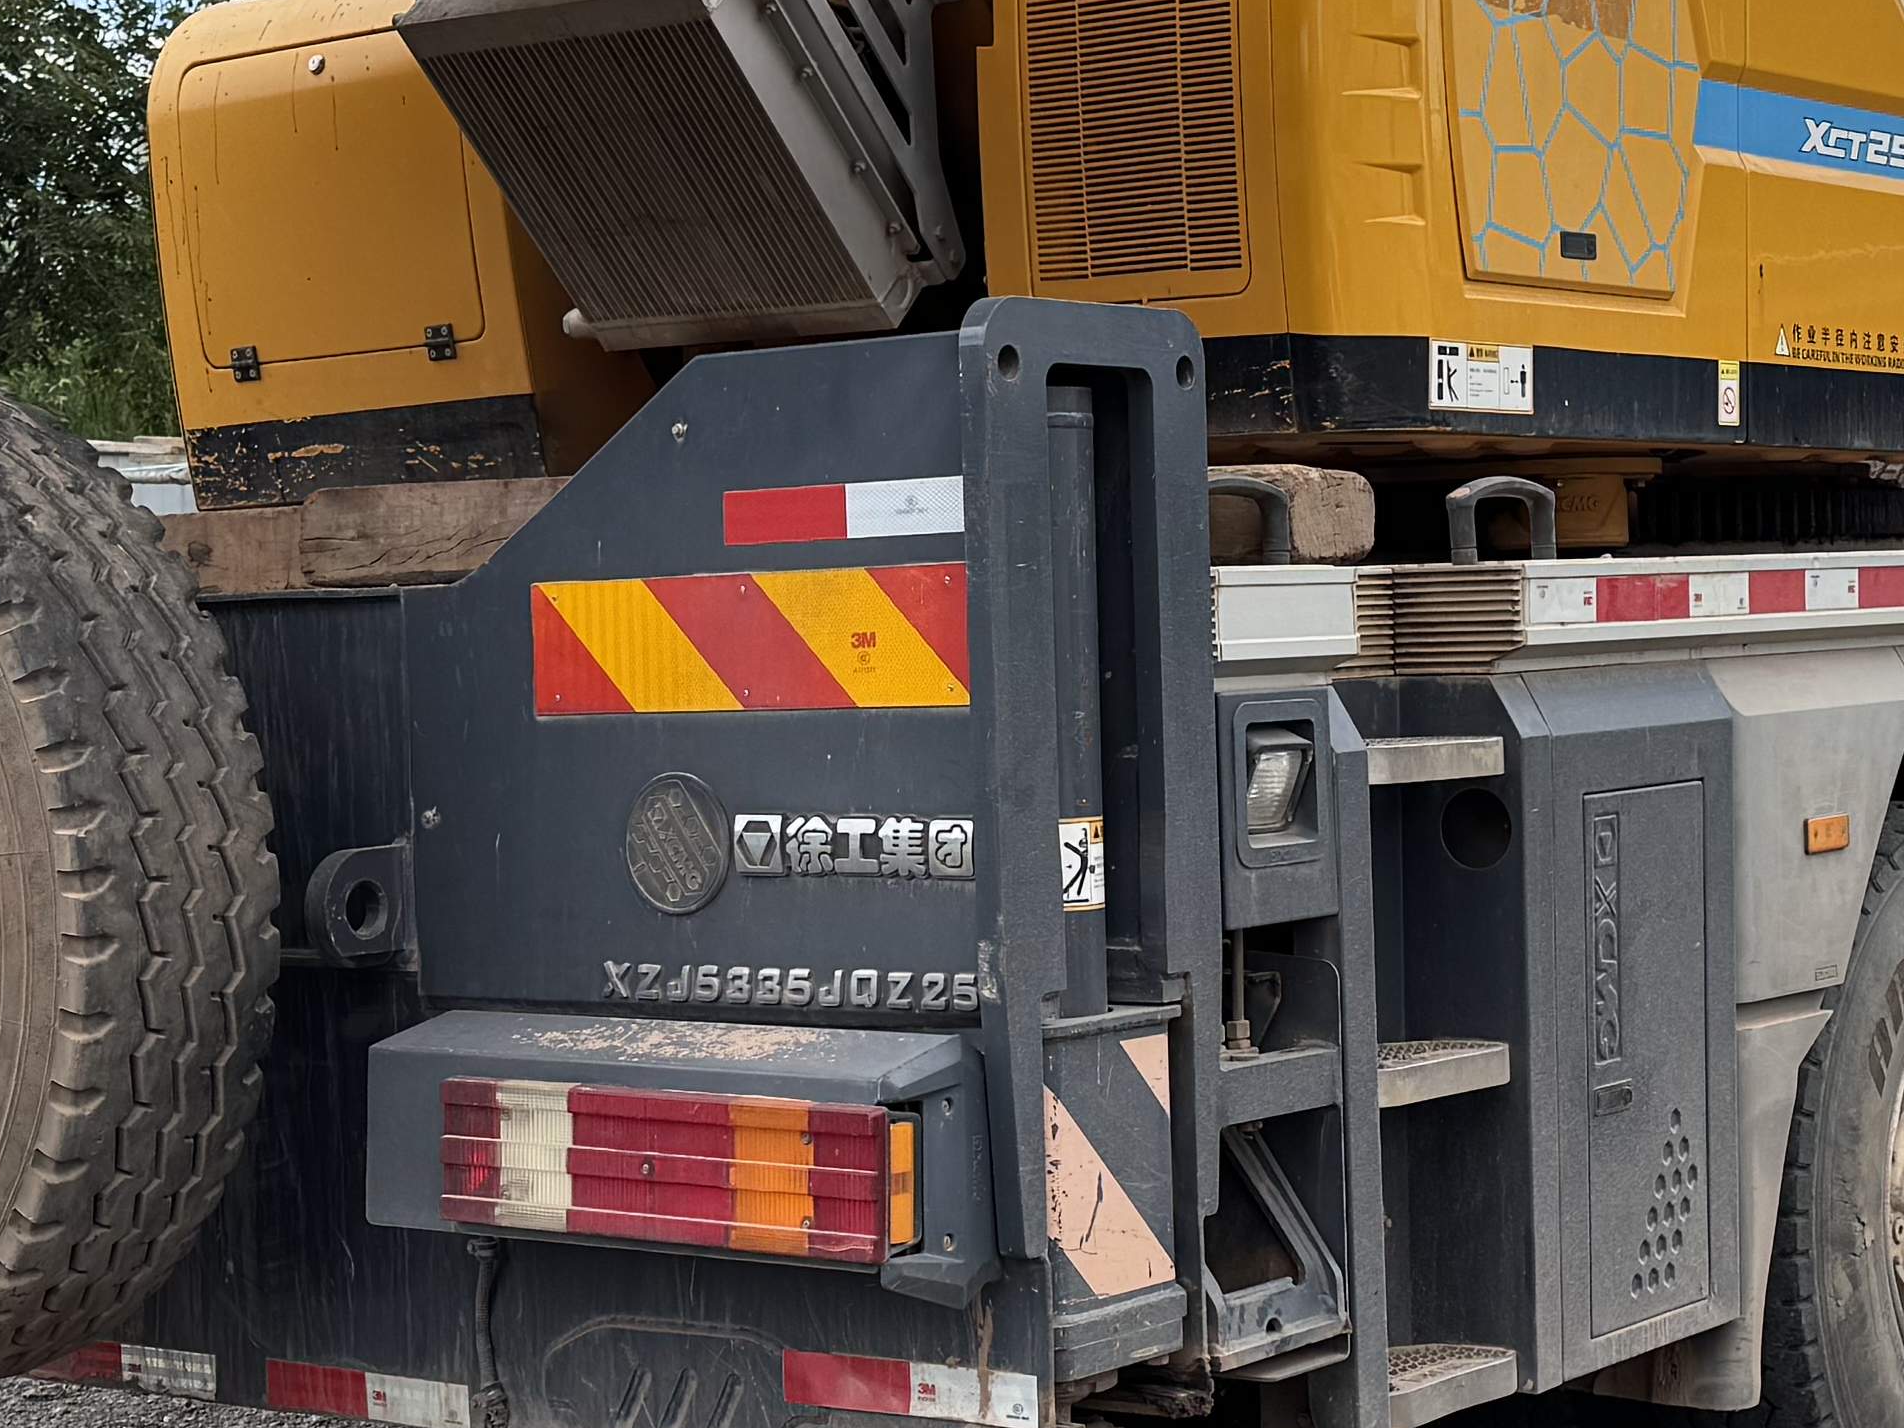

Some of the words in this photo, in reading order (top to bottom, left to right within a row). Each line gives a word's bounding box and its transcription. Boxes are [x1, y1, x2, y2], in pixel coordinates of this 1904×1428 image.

[1802, 348, 1831, 363] CAREFUL
[1559, 493, 1601, 514] CMG
[851, 631, 876, 649] 3M
[785, 815, 975, 879] 徐工集团
[601, 960, 981, 1012] XZJ5335JQZ25
[918, 1383, 936, 1396] 3M
